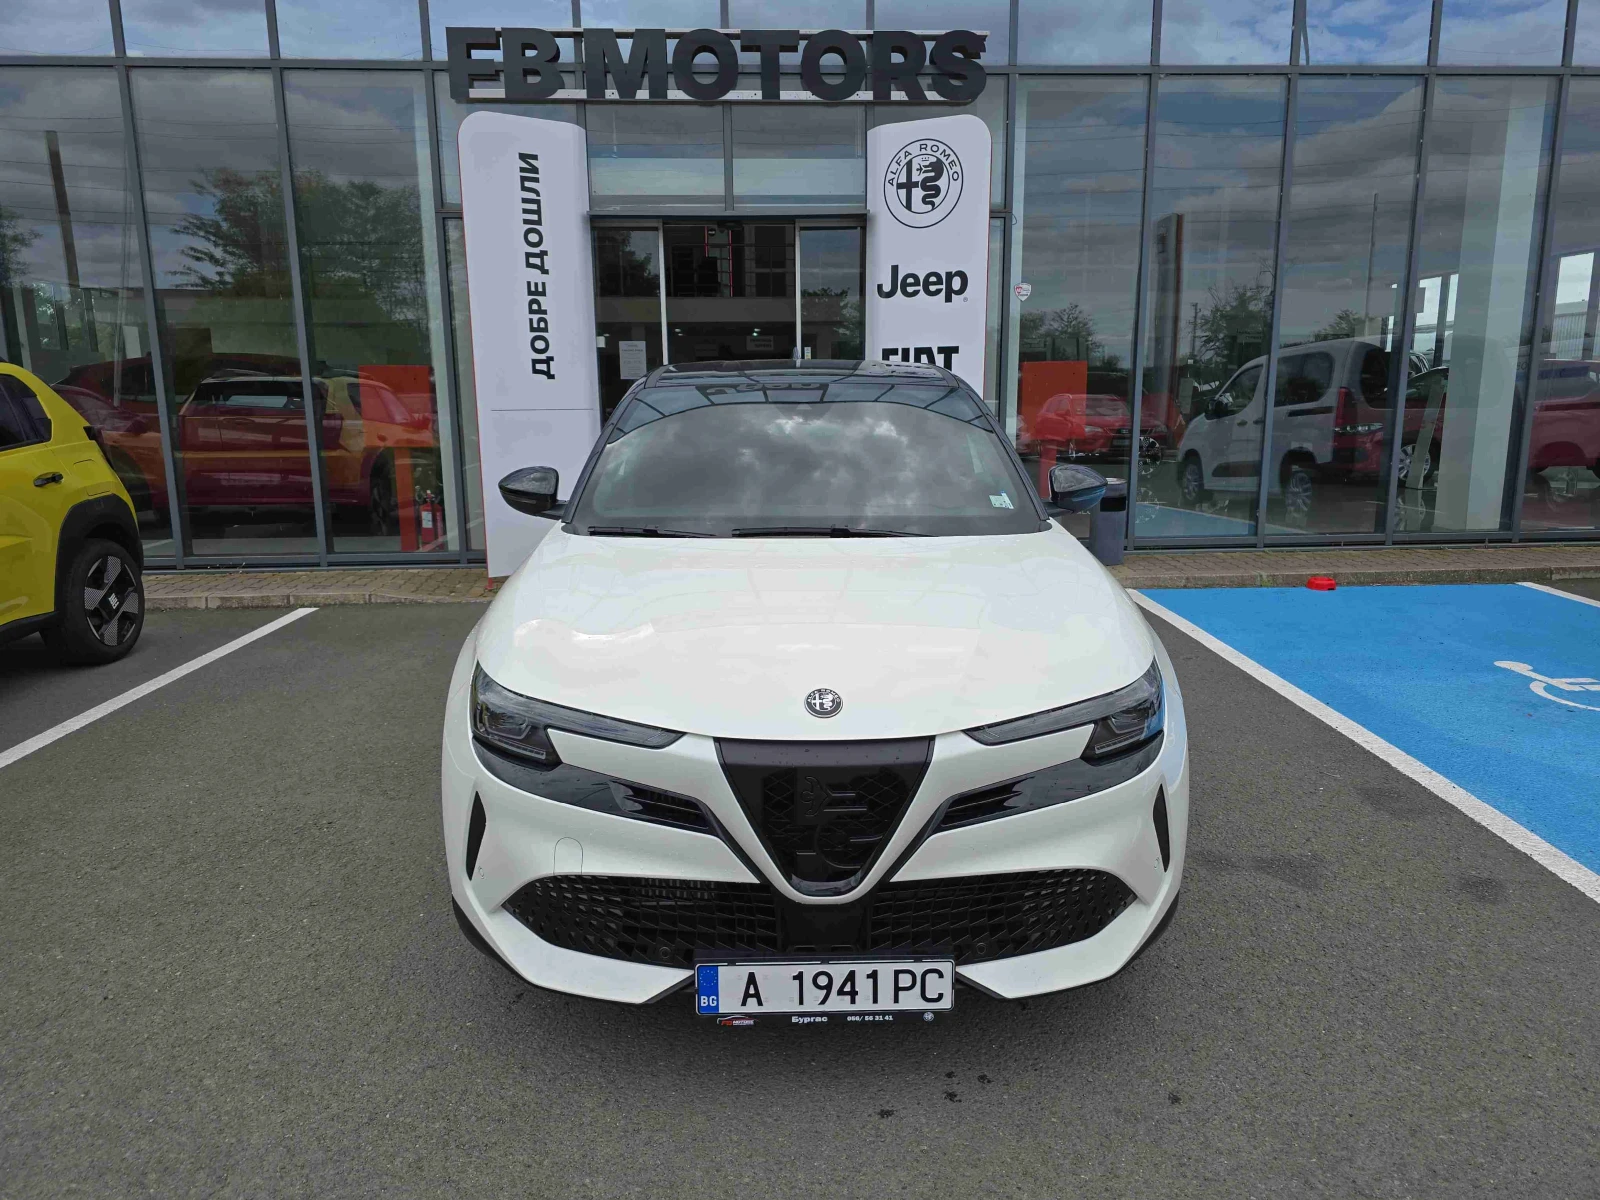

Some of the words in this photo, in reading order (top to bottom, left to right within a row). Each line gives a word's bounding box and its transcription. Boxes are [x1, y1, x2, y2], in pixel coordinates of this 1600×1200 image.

[445, 27, 566, 101] FB
[583, 27, 987, 103] MOTORS
[887, 149, 912, 187] ALFA
[919, 143, 960, 182] ROMEO
[518, 152, 550, 275] ДОШЛИ
[877, 264, 968, 303] Jeep
[525, 280, 556, 380] ДОБРЕ
[700, 996, 717, 1007] BG
[740, 972, 764, 1007] A
[792, 969, 879, 1006] 1941
[893, 968, 944, 1004] PC
[791, 1015, 828, 1023] Бургас
